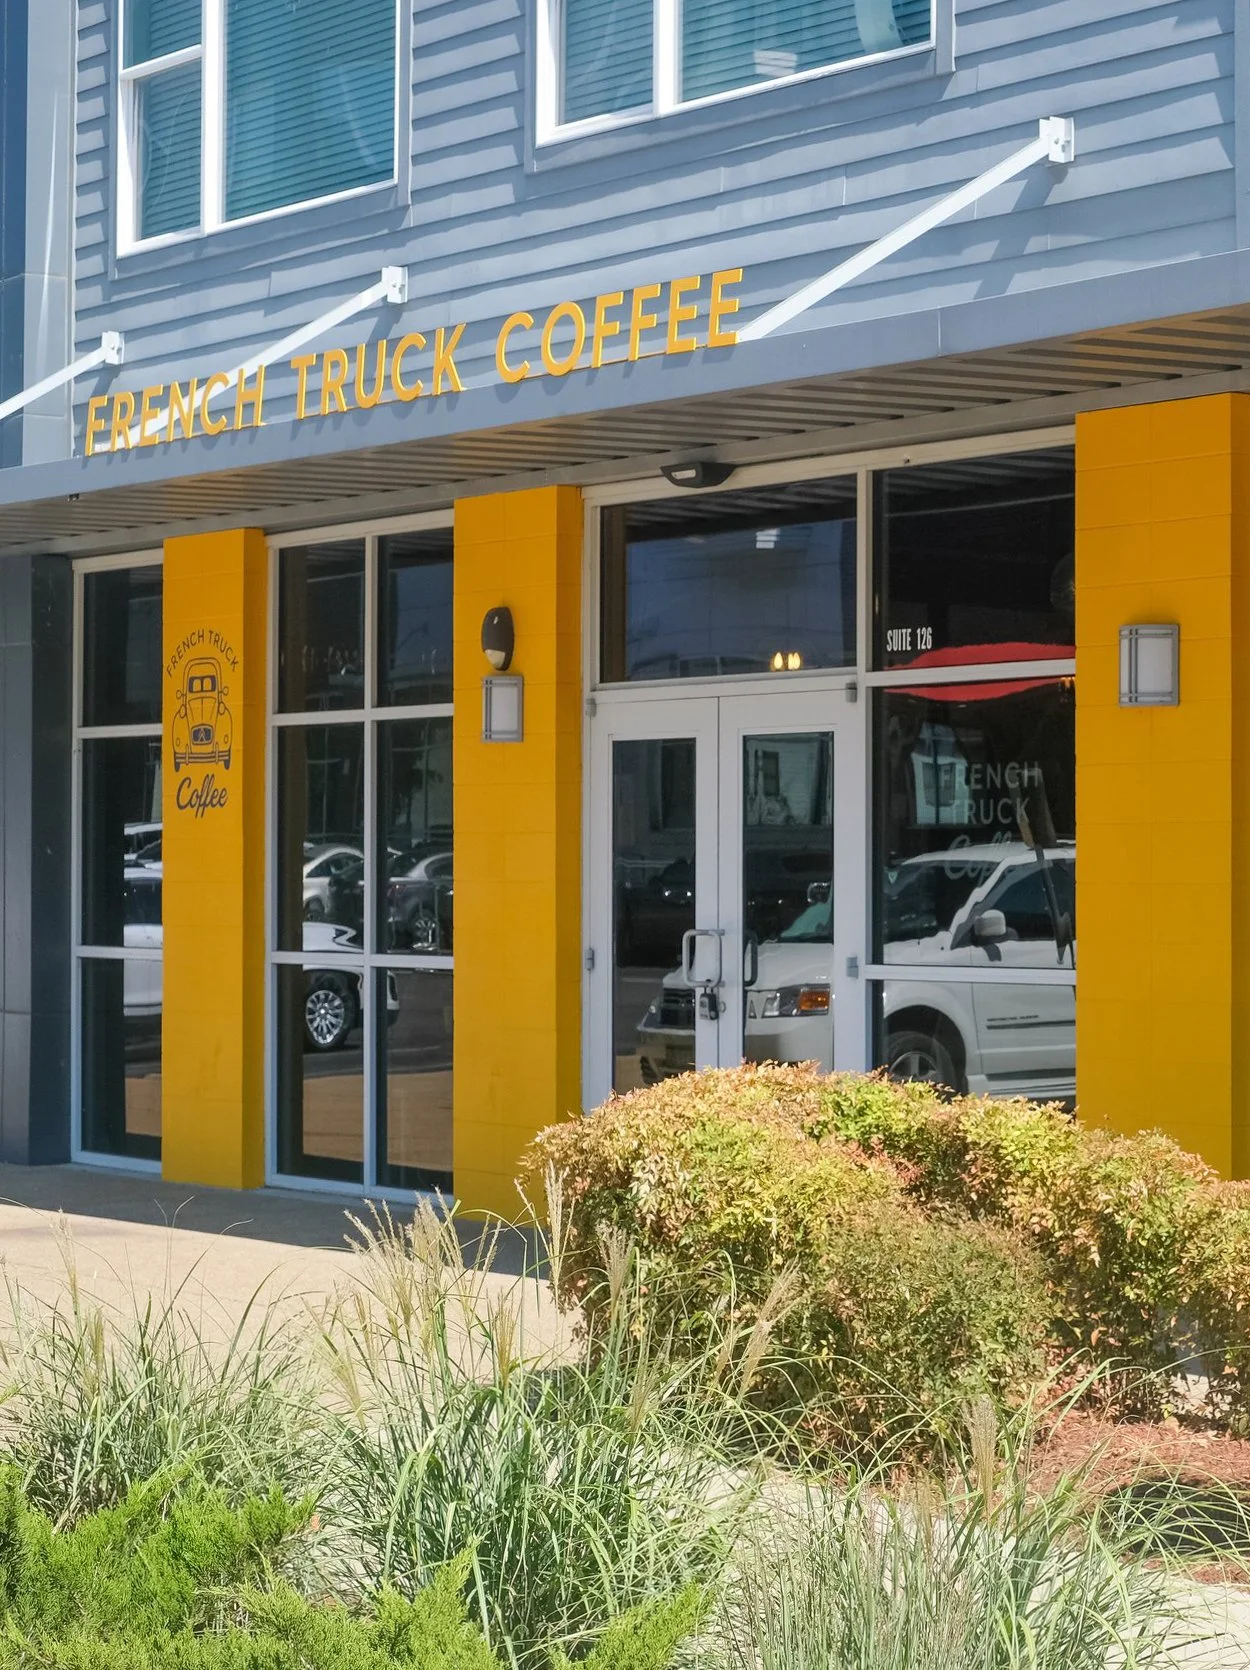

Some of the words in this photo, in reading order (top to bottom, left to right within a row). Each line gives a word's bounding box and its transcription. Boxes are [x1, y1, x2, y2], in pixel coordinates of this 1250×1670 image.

[84, 363, 266, 457] FRENCH
[290, 322, 467, 420] TRUCK
[495, 267, 744, 384] COFFEE
[166, 629, 205, 678] FRENCH
[208, 629, 240, 673] TRUCK
[886, 628, 912, 652] SUITE
[916, 626, 933, 650] 126
[176, 773, 229, 818] Coffee
[940, 760, 1040, 790] FENCH
